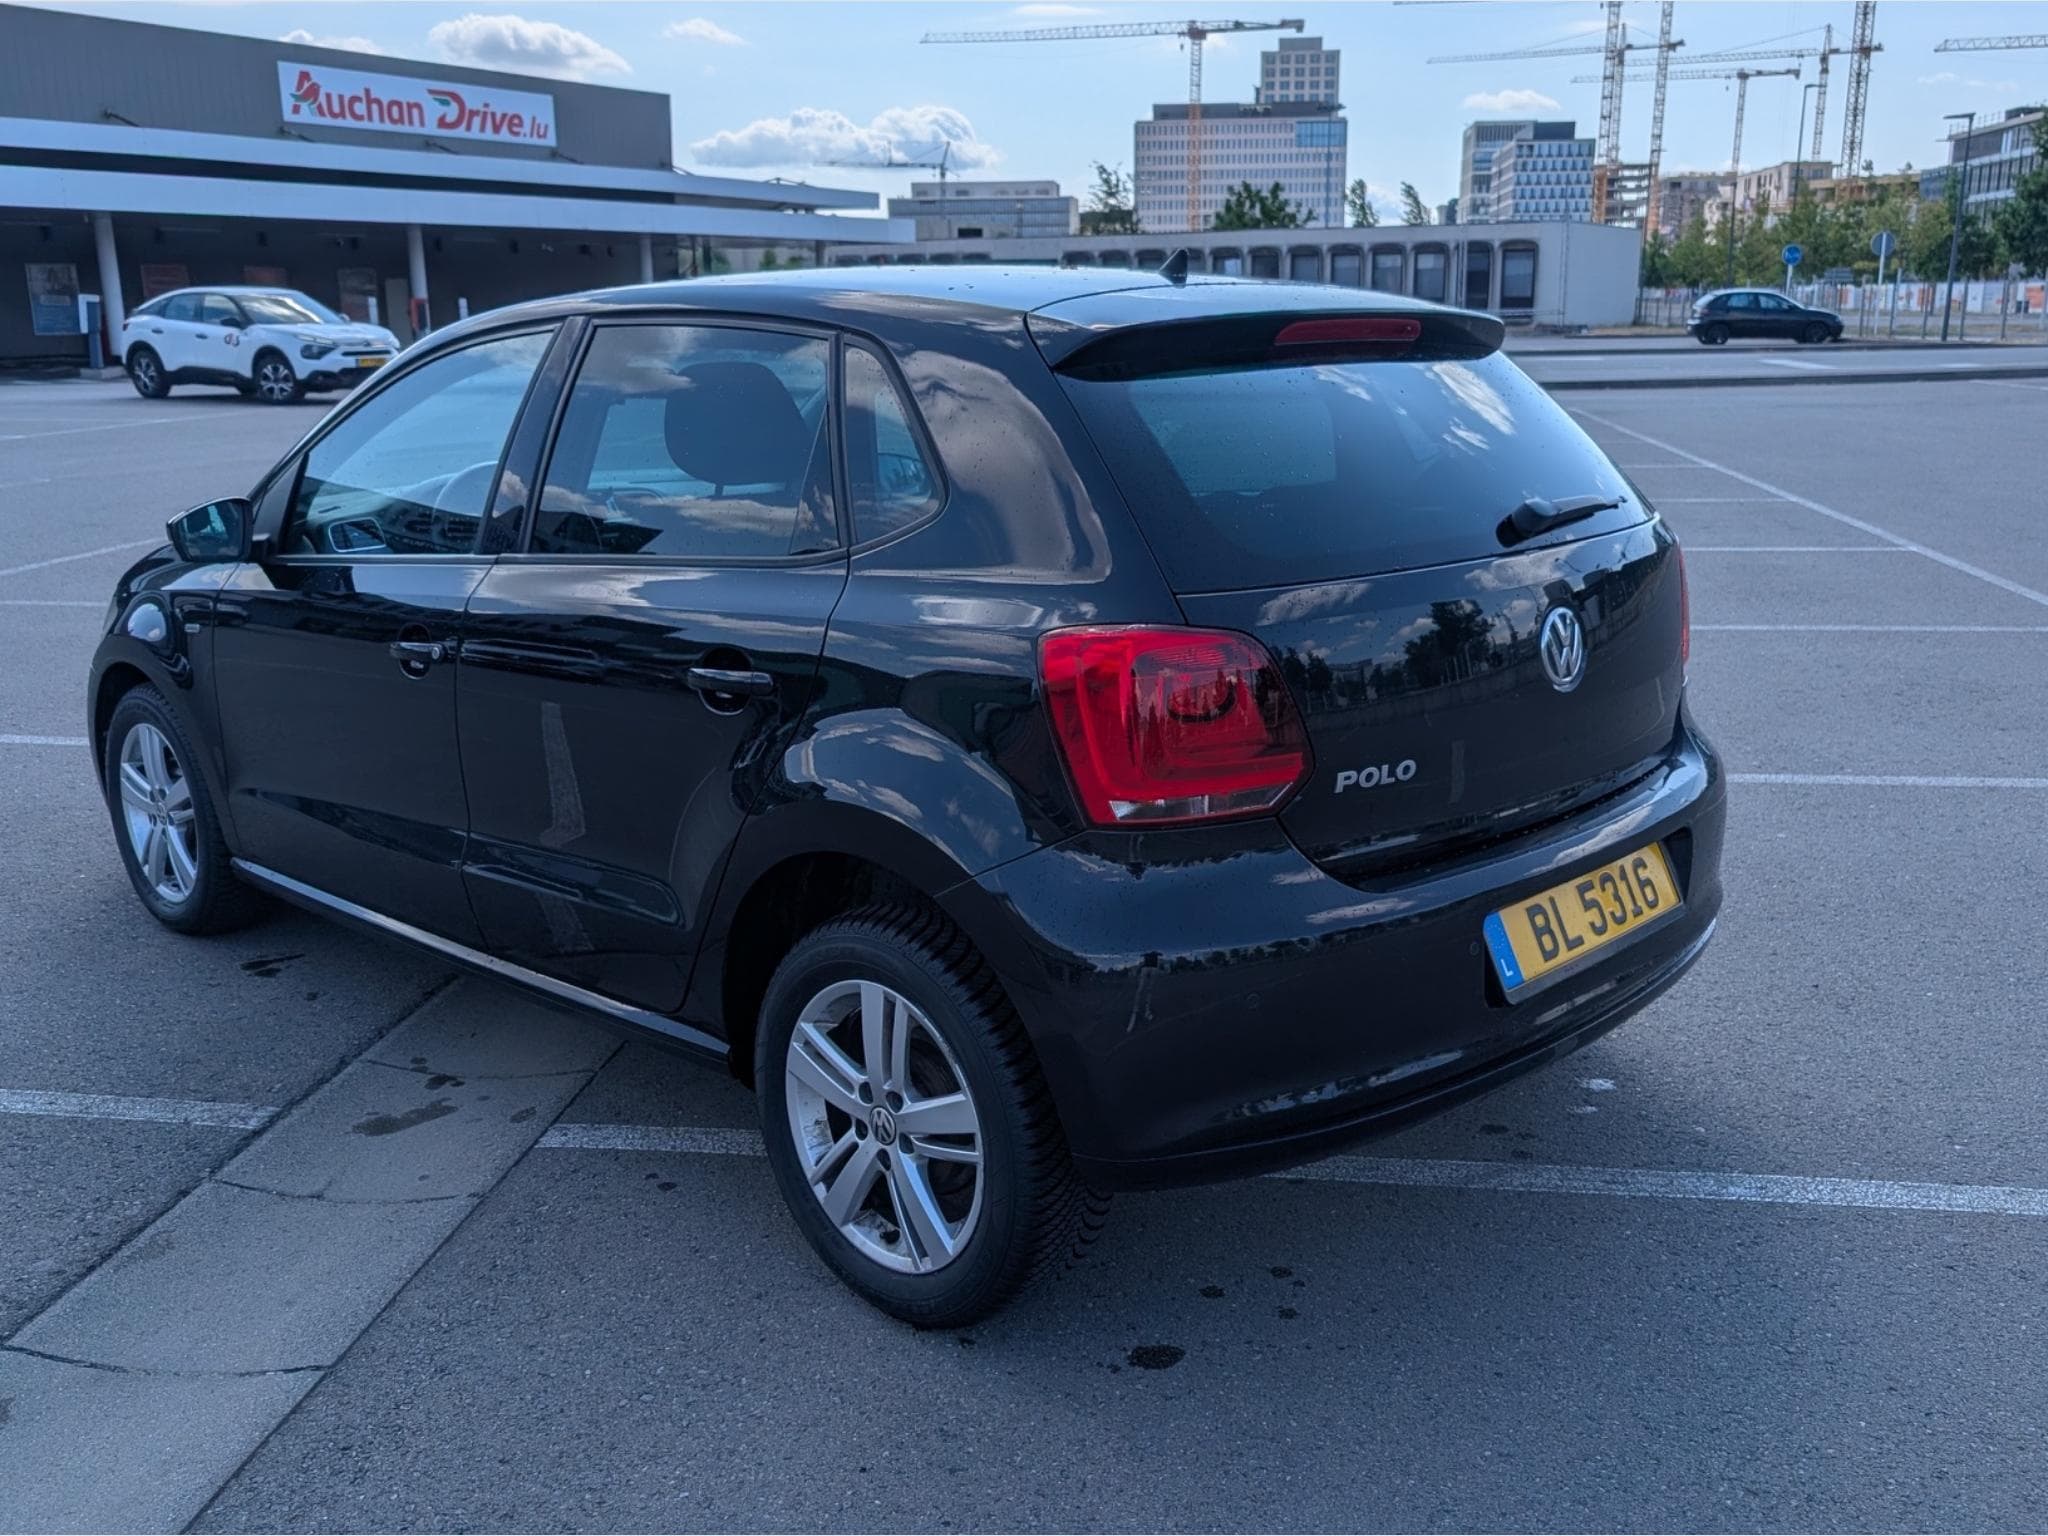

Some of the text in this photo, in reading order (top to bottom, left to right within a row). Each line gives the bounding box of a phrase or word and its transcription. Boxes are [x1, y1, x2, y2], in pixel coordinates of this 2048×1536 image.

[289, 70, 549, 140] Auchan Drive.lu
[1540, 606, 1584, 689] VW
[1334, 759, 1417, 794] POLO
[1525, 857, 1660, 963] BL 5316
[1501, 958, 1513, 977] L
